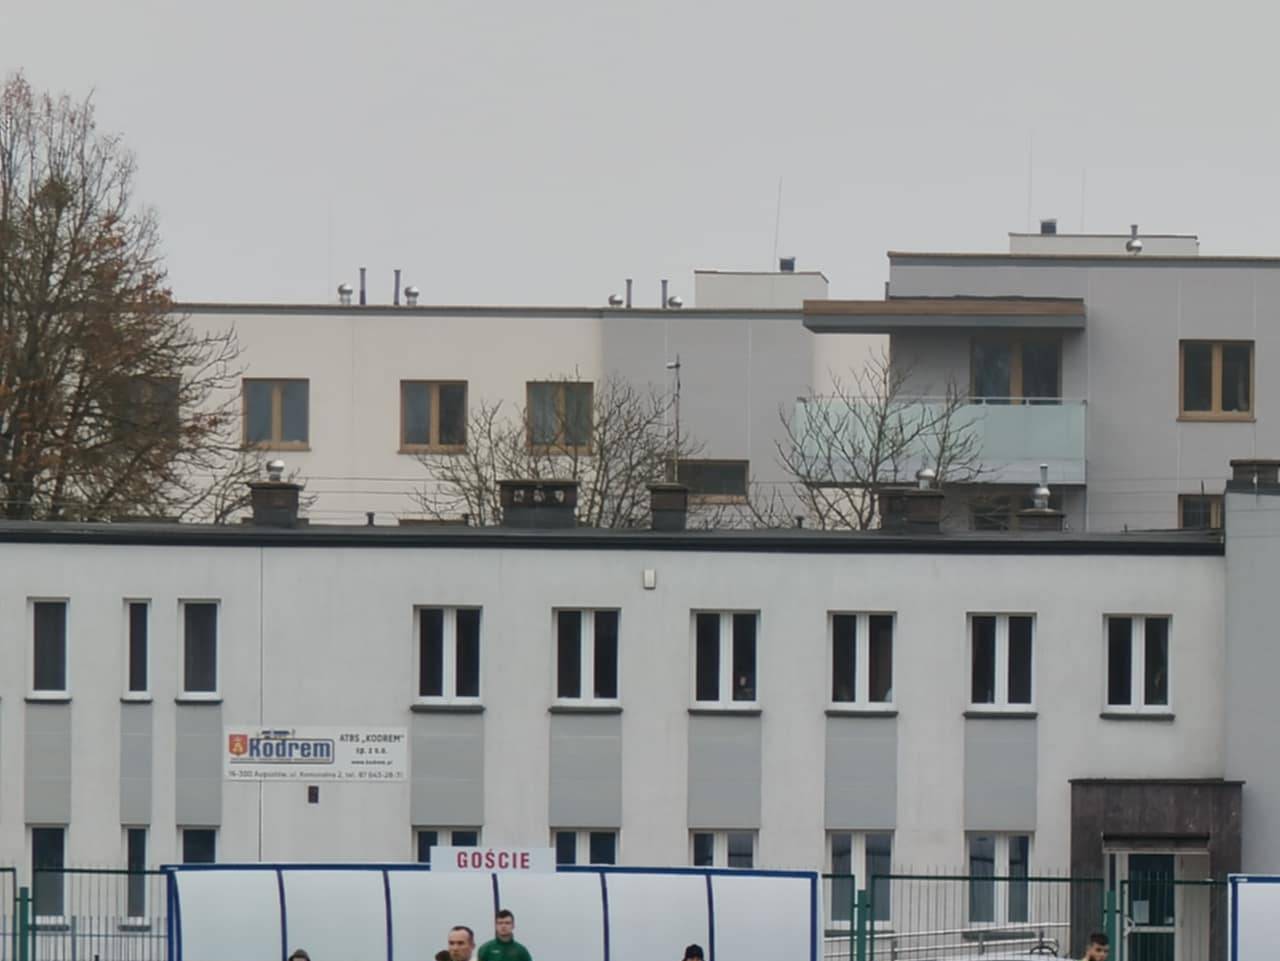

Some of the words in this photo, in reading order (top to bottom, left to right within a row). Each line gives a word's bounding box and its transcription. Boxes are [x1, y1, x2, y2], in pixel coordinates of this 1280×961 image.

[249, 738, 331, 758] Kodrem
[340, 734, 360, 743] ATBS
[457, 848, 530, 869] GOŚCIE
